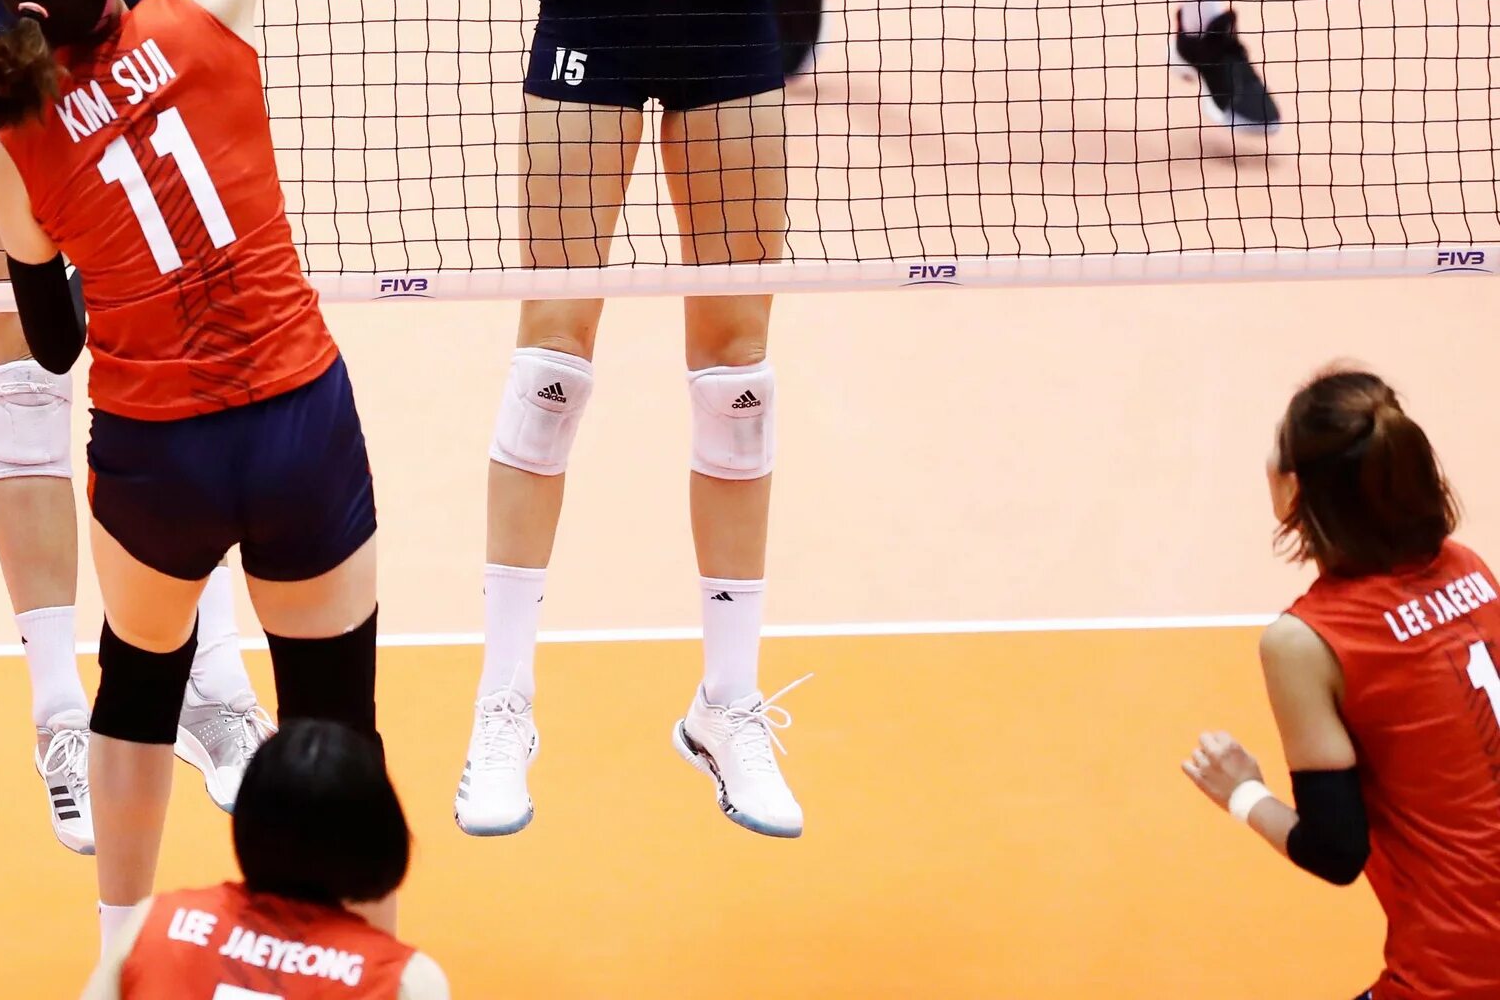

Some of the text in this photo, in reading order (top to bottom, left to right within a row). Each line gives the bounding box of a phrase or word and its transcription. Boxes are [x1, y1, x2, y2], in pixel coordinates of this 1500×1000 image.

[551, 47, 588, 85] 15
[55, 38, 177, 143] KIM SUJI
[97, 107, 237, 275] 11
[909, 265, 956, 279] FIVB
[1438, 252, 1484, 266] FIVB
[381, 278, 428, 292] FIVB
[537, 391, 566, 403] adidas
[732, 401, 761, 409] adidas
[1383, 599, 1433, 642] LEE
[167, 907, 365, 987] LEE JAEYEONG
